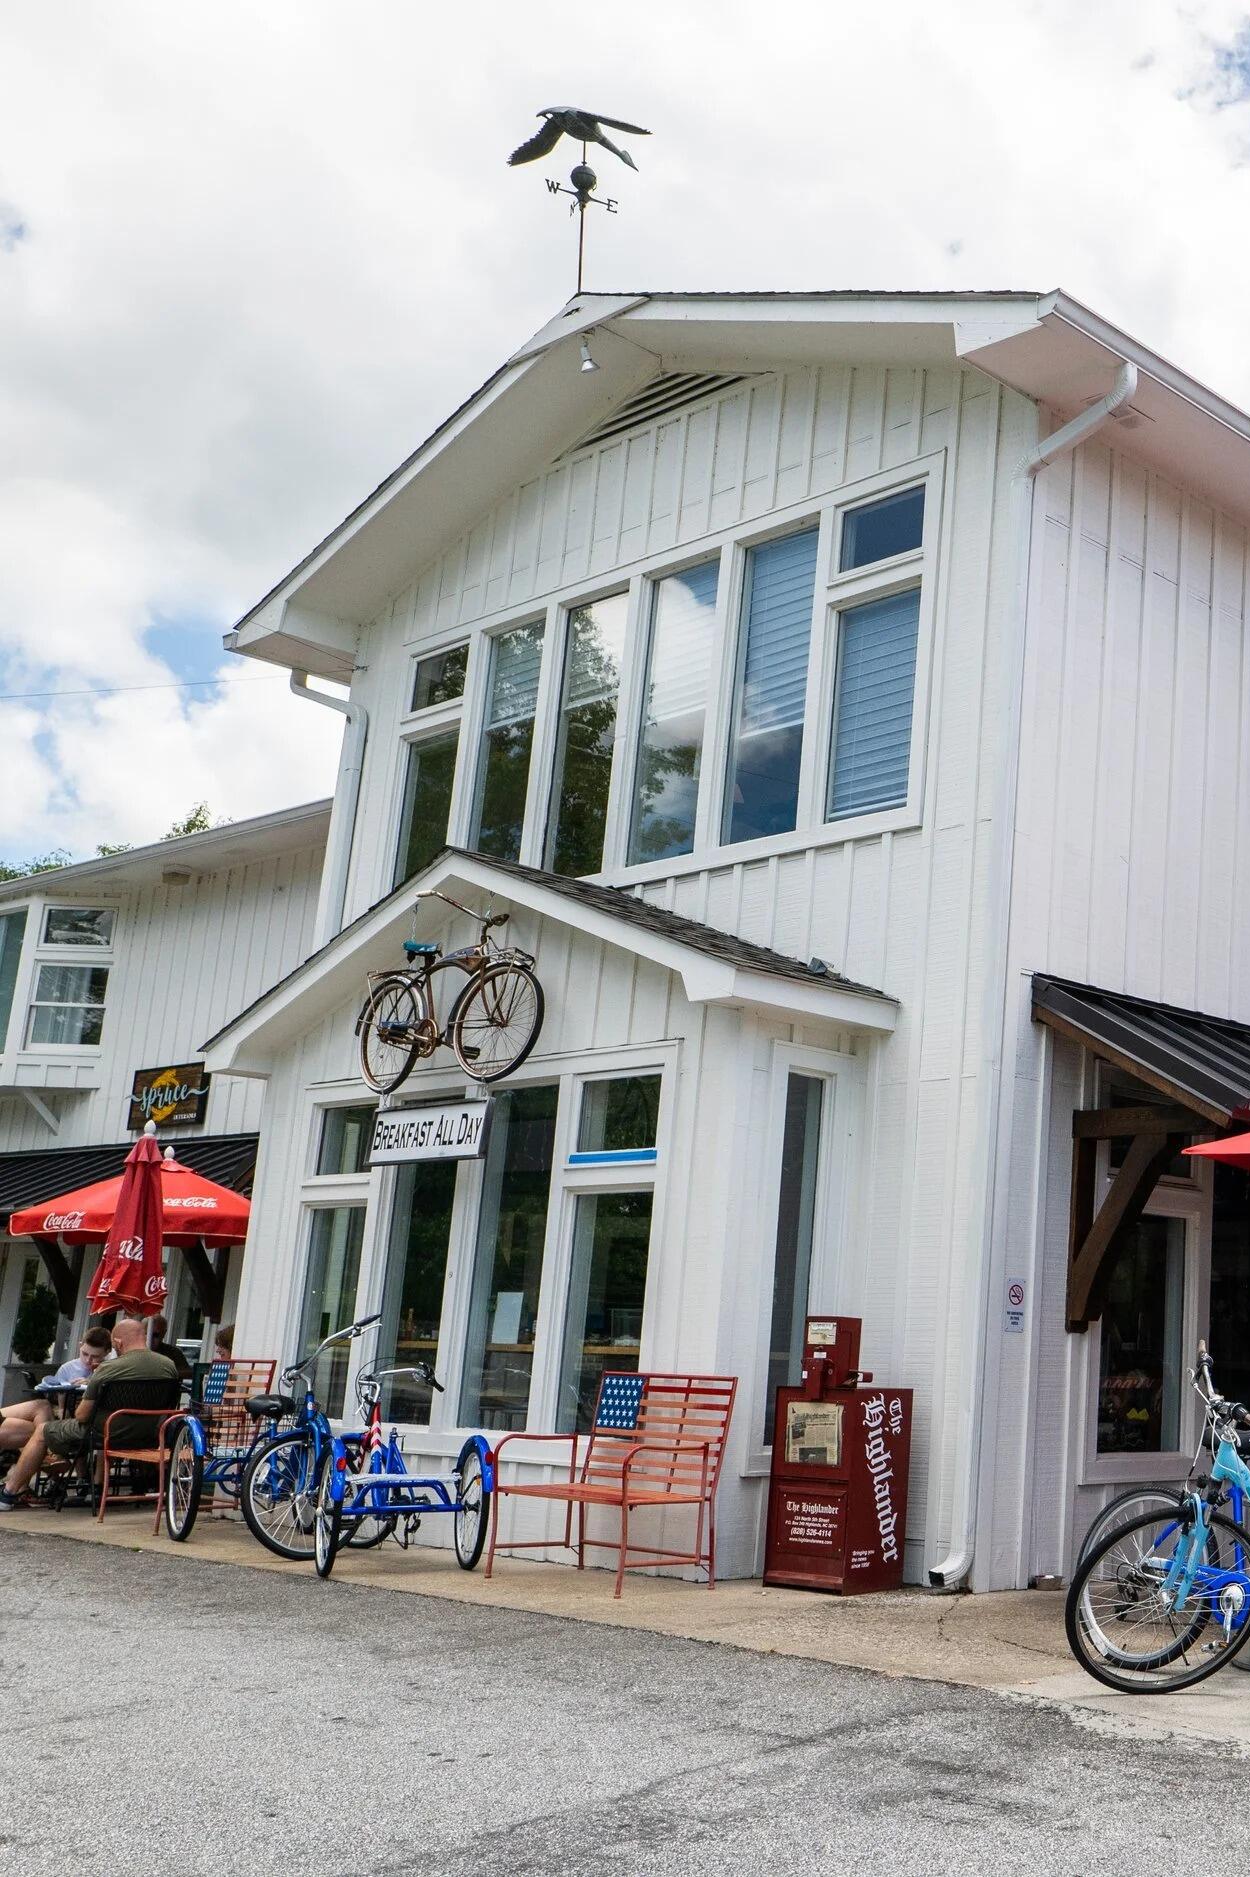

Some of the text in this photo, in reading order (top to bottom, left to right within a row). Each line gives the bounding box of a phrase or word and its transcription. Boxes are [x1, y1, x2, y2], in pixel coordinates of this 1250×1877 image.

[545, 178, 560, 194] W
[606, 198, 618, 214] E
[372, 1113, 483, 1151] BREAKFAST ALL DAY
[889, 1397, 903, 1437] The
[861, 1393, 898, 1563] Highlander
[786, 1501, 839, 1515] The Highlander
